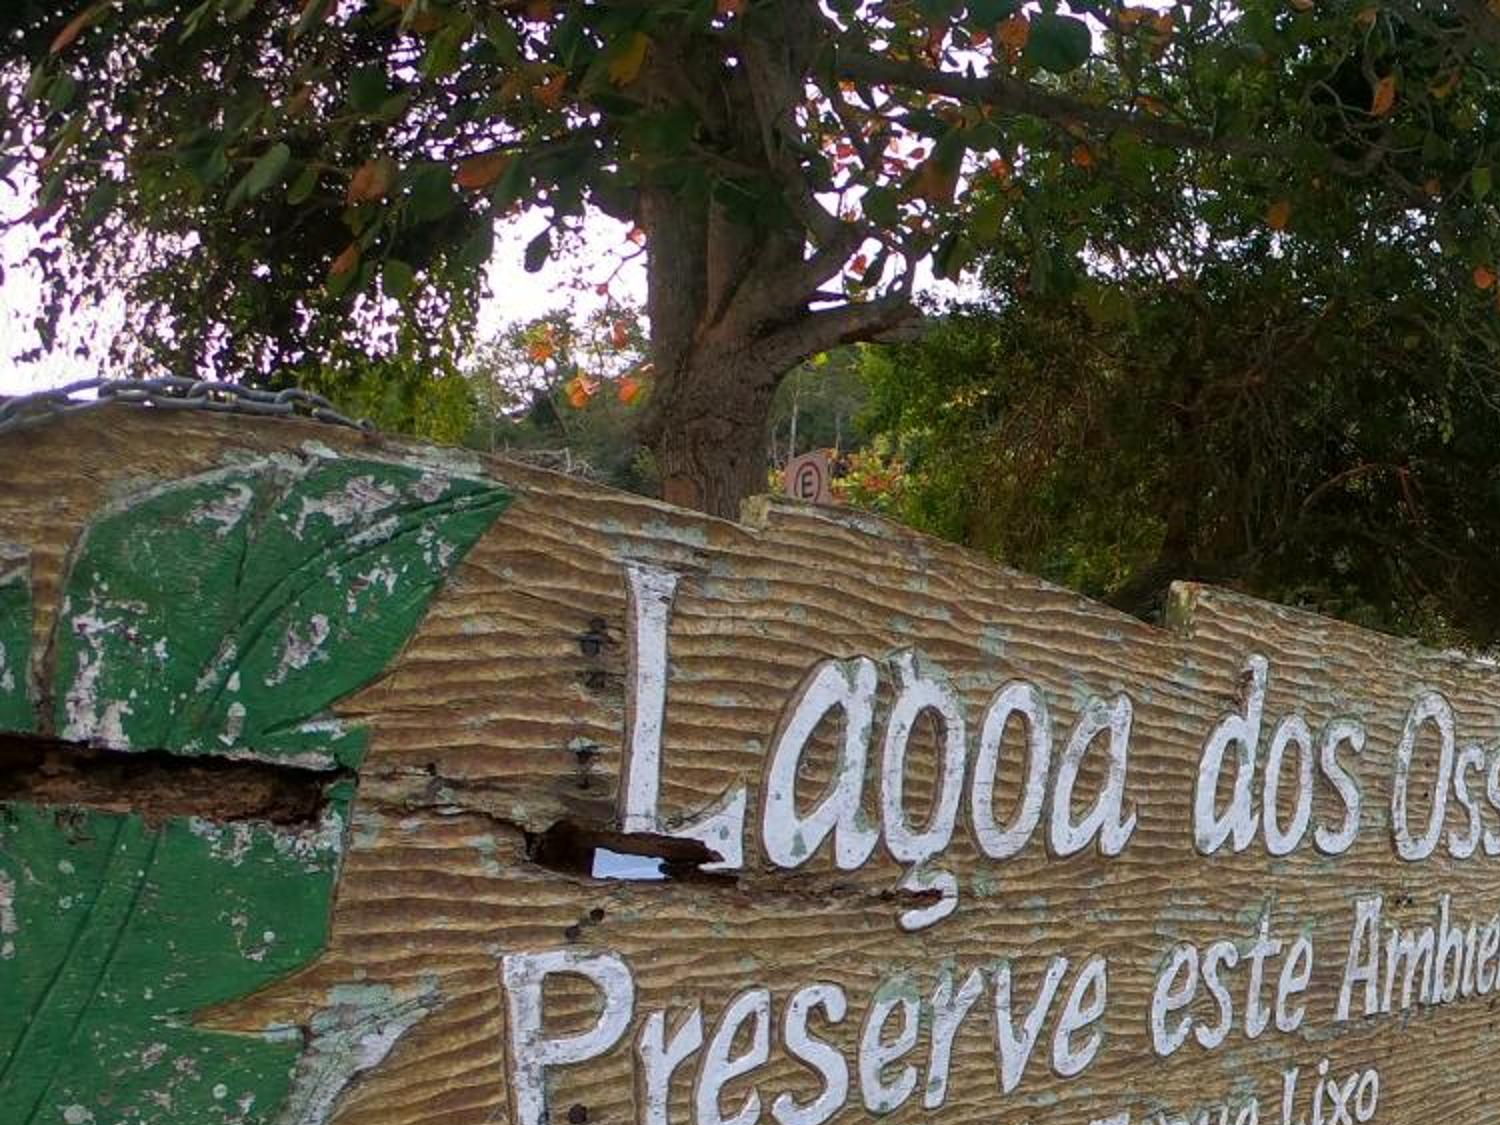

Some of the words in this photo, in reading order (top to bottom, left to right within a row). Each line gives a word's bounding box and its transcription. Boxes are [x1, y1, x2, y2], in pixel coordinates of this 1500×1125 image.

[622, 564, 1137, 932] Lagoa
[1196, 654, 1366, 856] dos
[1153, 908, 1313, 1057] este
